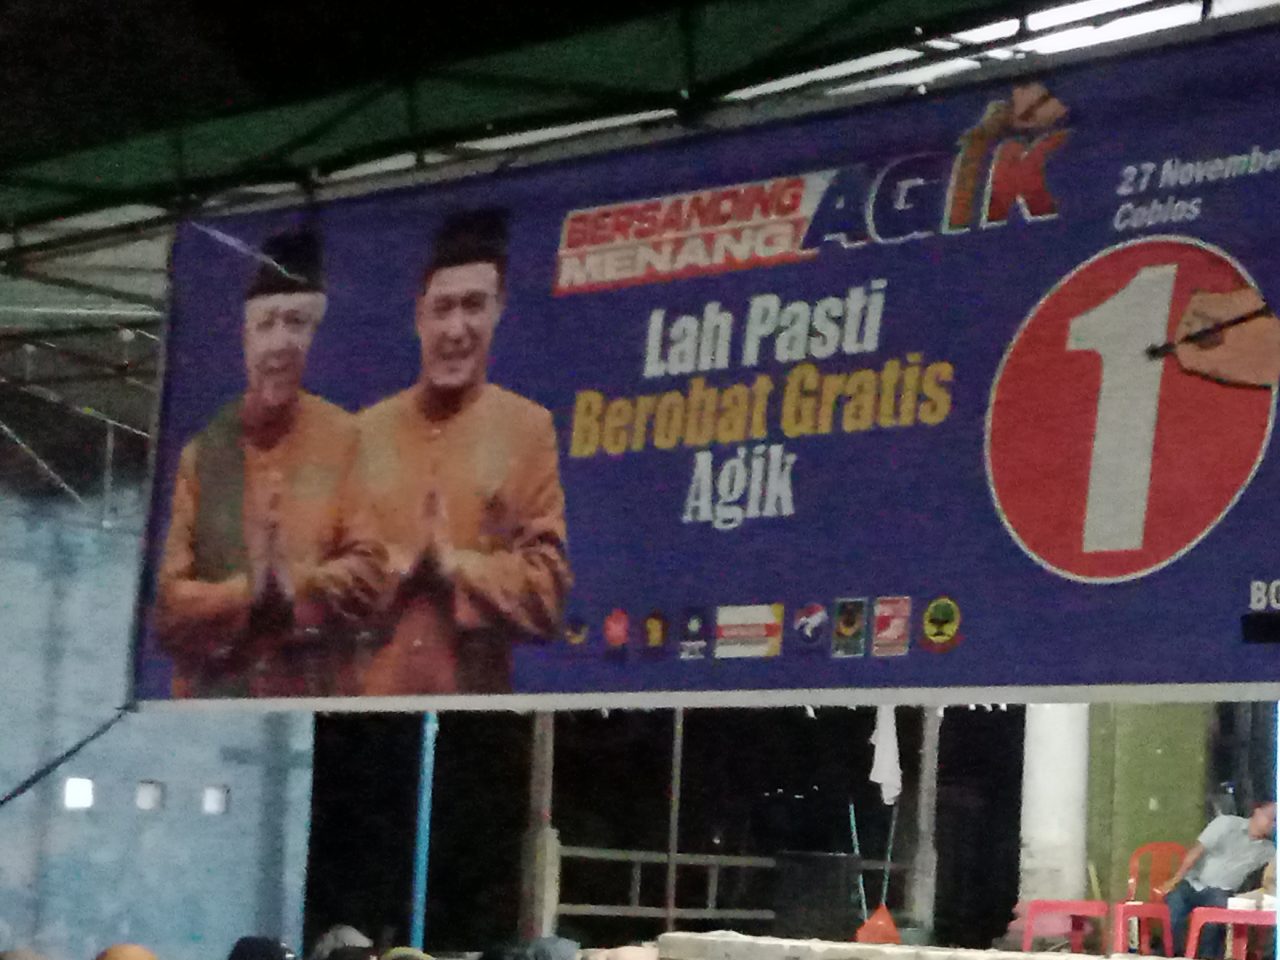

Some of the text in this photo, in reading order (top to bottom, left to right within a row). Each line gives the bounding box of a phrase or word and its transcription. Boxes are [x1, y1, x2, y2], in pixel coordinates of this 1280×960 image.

[1116, 162, 1157, 196] 27
[557, 221, 796, 289] MENANG
[642, 279, 888, 379] Lah Pasti
[569, 353, 954, 458] Berobat Gratis
[1066, 263, 1180, 554] 1
[682, 443, 798, 530] Agik
